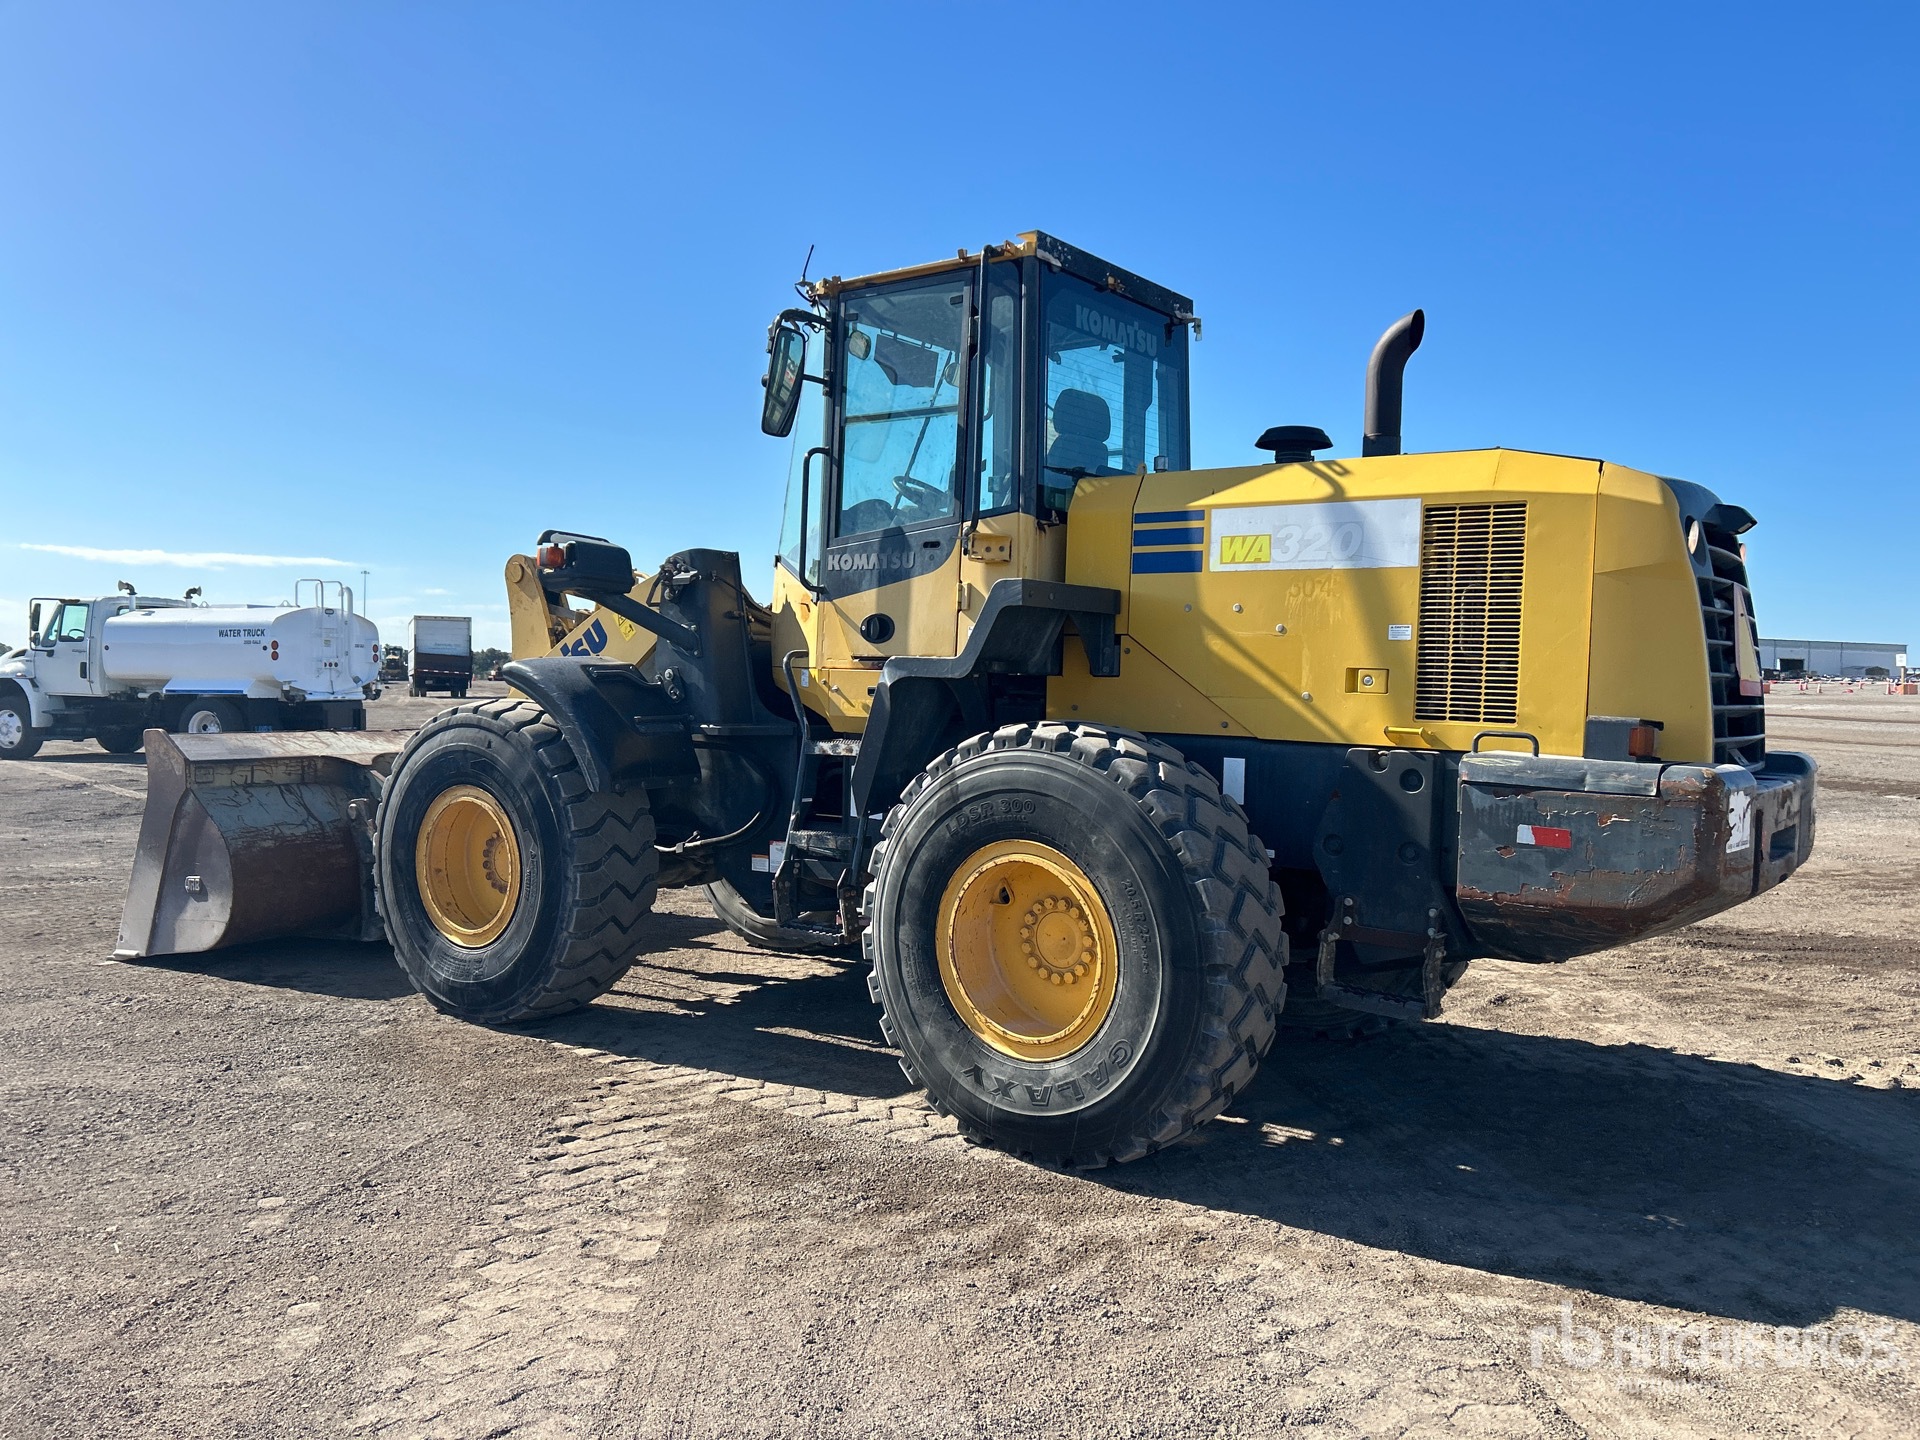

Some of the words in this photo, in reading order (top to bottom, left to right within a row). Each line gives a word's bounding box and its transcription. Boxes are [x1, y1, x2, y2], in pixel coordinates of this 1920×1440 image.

[1076, 304, 1157, 357] KOMATSU
[827, 551, 915, 571] KOMATSU
[218, 628, 241, 637] WATER
[243, 628, 265, 637] TRUCK
[945, 801, 994, 838] LDSR
[1000, 798, 1036, 815] 300
[960, 1038, 1135, 1108] GALAXY
